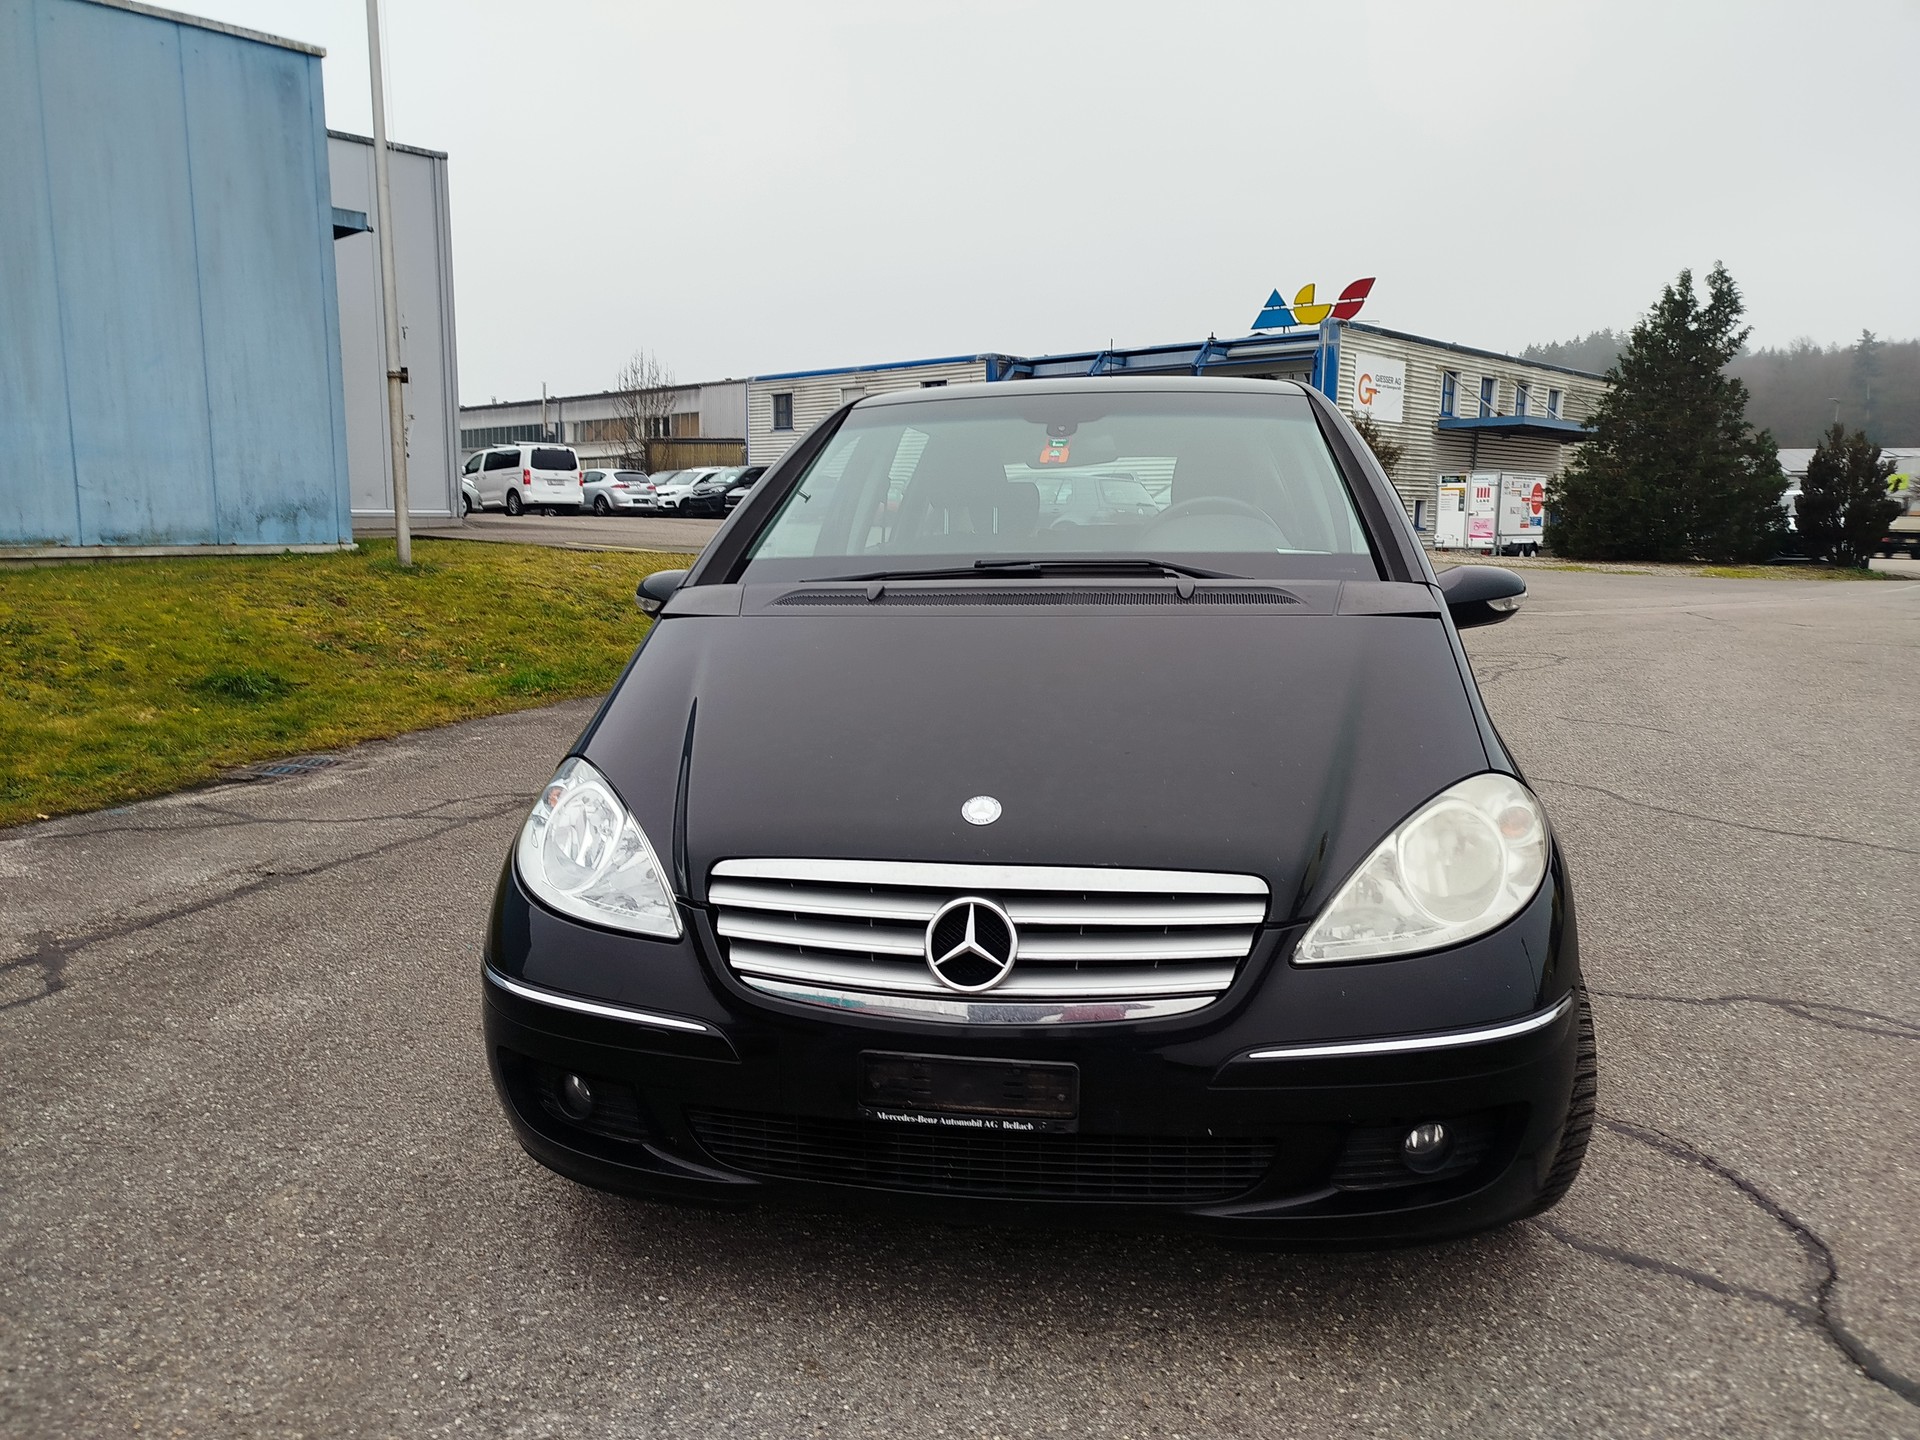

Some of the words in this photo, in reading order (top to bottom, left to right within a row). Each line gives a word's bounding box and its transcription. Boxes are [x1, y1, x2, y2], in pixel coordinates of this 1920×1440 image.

[1375, 374, 1394, 384] GIESSER
[1395, 377, 1402, 385] AG
[876, 1111, 938, 1124] Mercedes-Benz
[940, 1117, 983, 1128] Automobil
[984, 1120, 998, 1128] AG
[1002, 1120, 1034, 1131] Bellach
